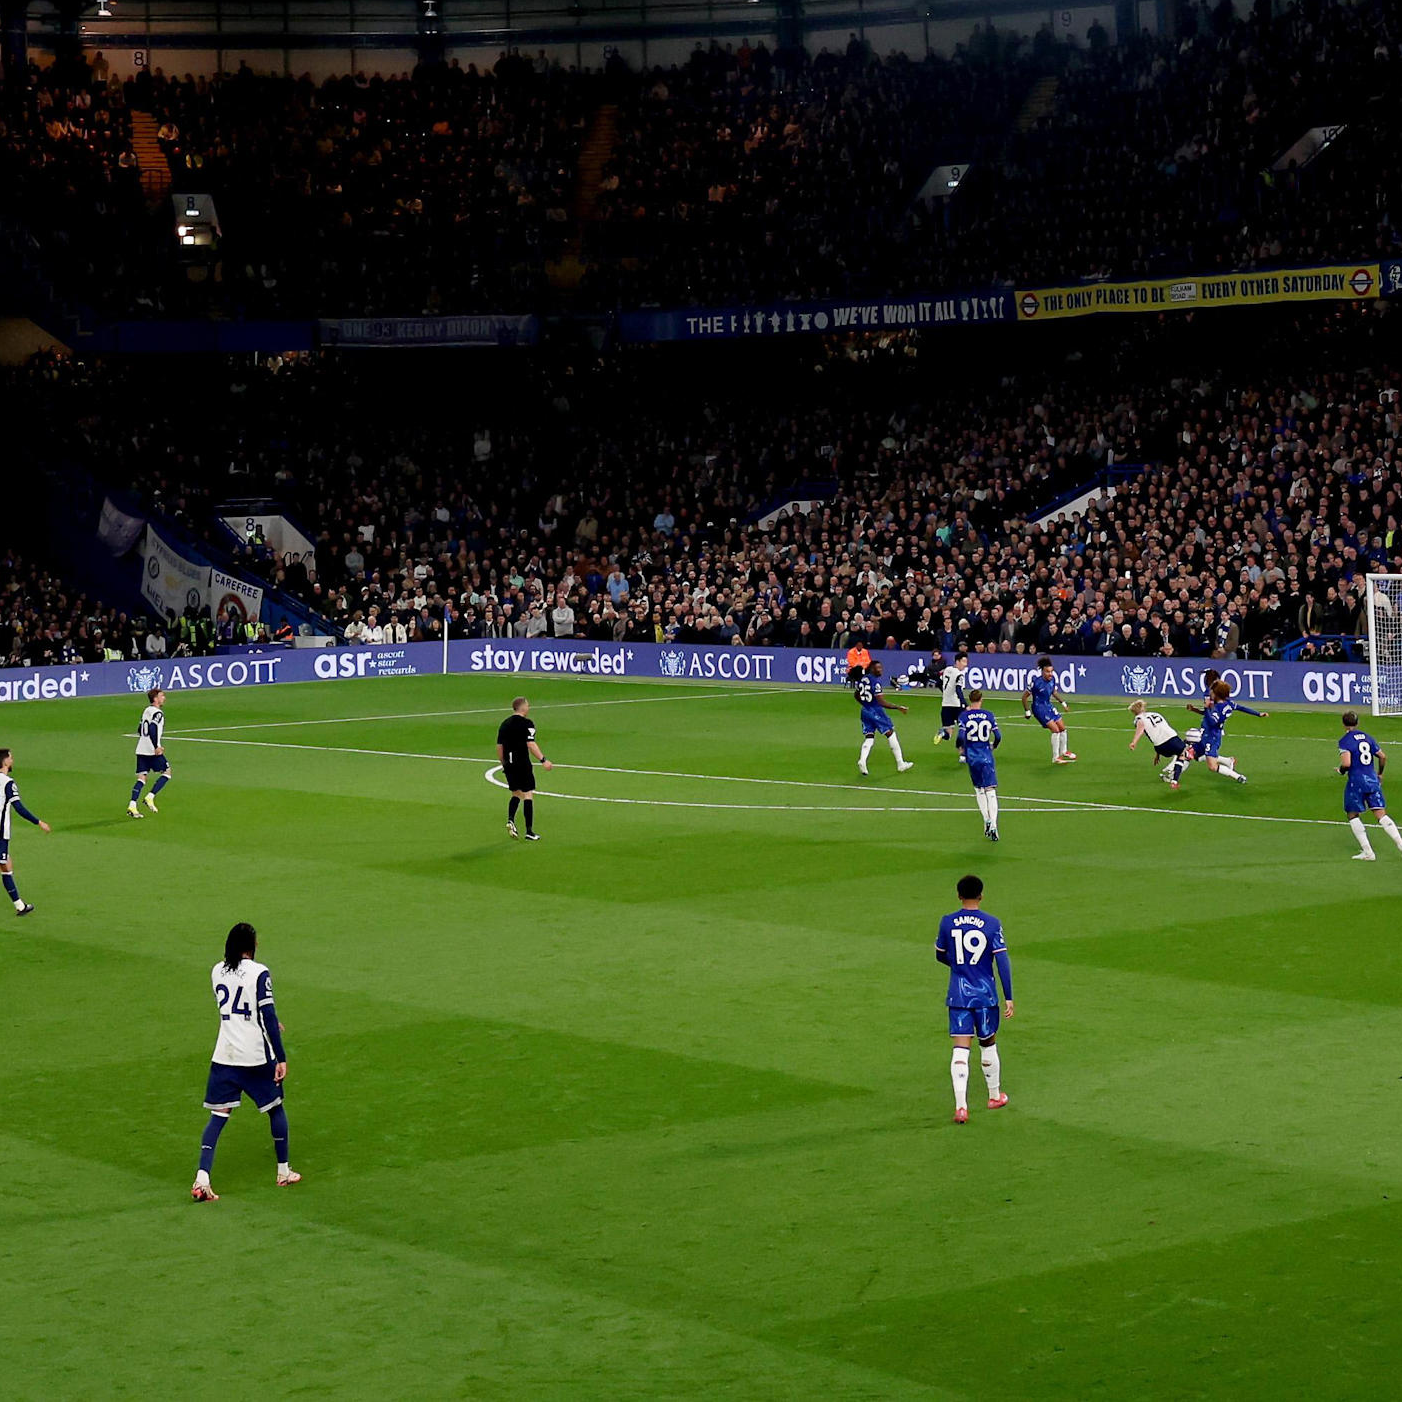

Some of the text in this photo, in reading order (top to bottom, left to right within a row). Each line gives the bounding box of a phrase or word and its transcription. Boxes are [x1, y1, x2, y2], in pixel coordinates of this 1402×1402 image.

[1043, 295, 1063, 311] THE
[1067, 291, 1092, 309] ONLY
[1096, 289, 1129, 304] PLACE
[1134, 289, 1147, 304] TO
[1202, 281, 1236, 299] EVERY
[1240, 278, 1279, 297] OTHER
[1283, 274, 1345, 293] SATURDAY
[686, 316, 724, 335] THE
[833, 306, 878, 326] WE'VE
[883, 303, 915, 324] WON
[918, 302, 932, 322] IT
[934, 301, 957, 321] ALL
[245, 517, 254, 532] 8
[215, 573, 259, 599] CAREFREE
[314, 652, 370, 679] asr
[377, 650, 405, 660] ascott
[377, 659, 398, 667] star
[471, 645, 625, 675] stay rewaded
[688, 653, 774, 680] ASCOTT
[167, 657, 282, 690] ASCOTT
[377, 664, 417, 675] rewards
[796, 655, 836, 683] asr
[858, 683, 873, 702] 25
[1302, 671, 1357, 703] asr
[965, 720, 992, 742] 20
[1358, 741, 1372, 766] 8
[953, 915, 985, 929] SANCHO
[951, 929, 988, 966] 19
[215, 984, 252, 1021] 24
